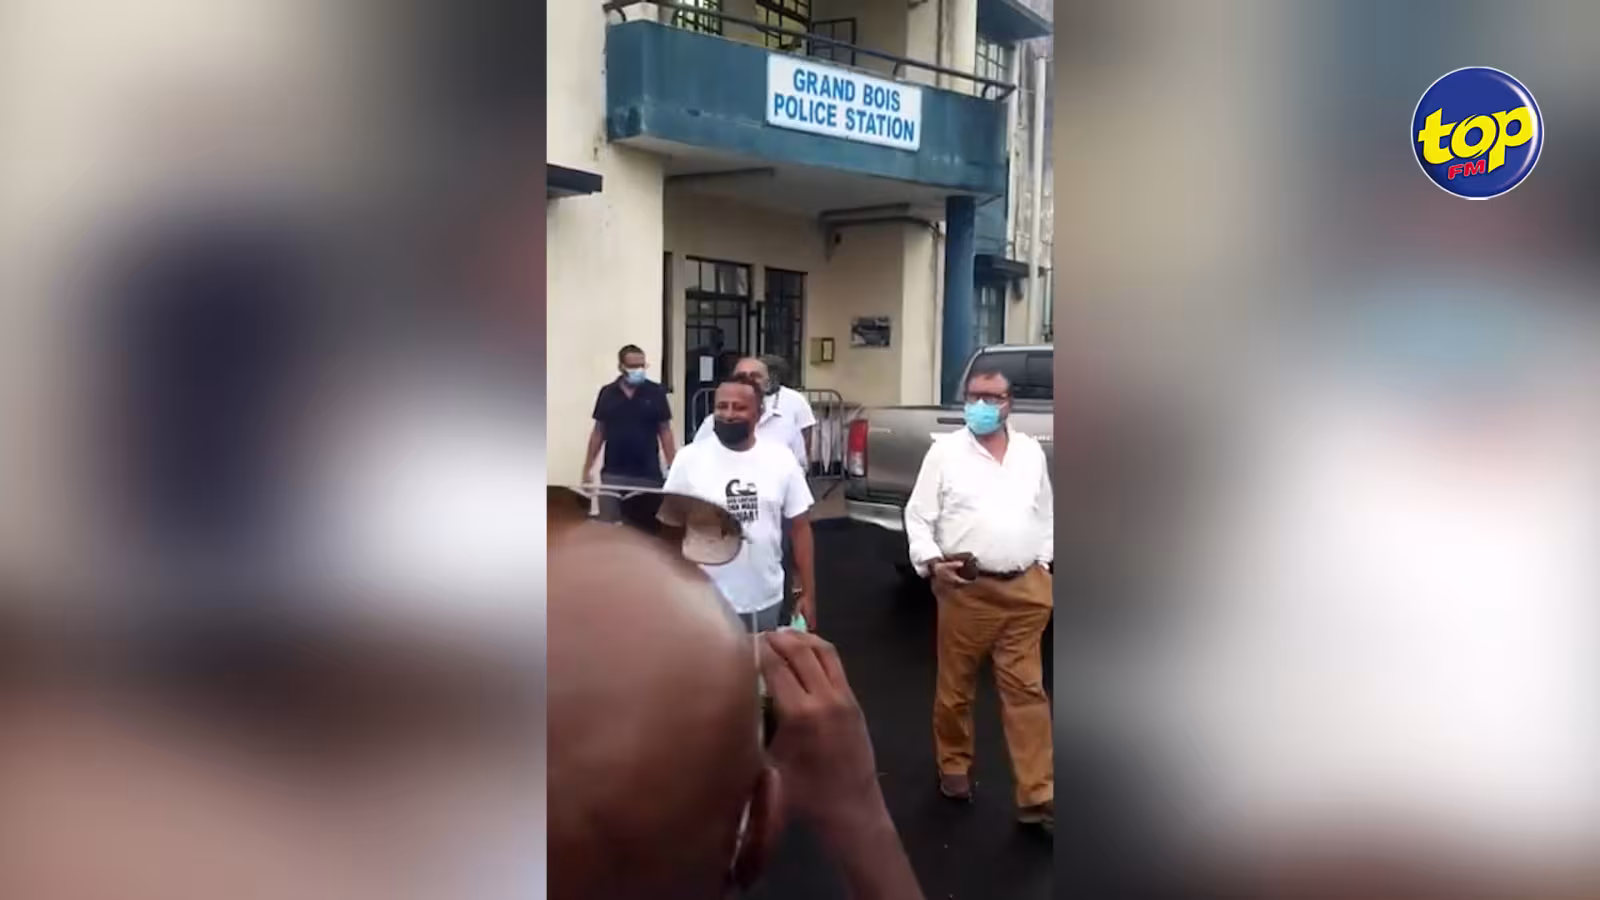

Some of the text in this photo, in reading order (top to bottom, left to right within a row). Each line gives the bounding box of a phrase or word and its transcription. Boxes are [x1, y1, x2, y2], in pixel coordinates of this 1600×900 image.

[793, 68, 900, 112] GRAND BOIS
[774, 92, 914, 142] POLICE STATION
